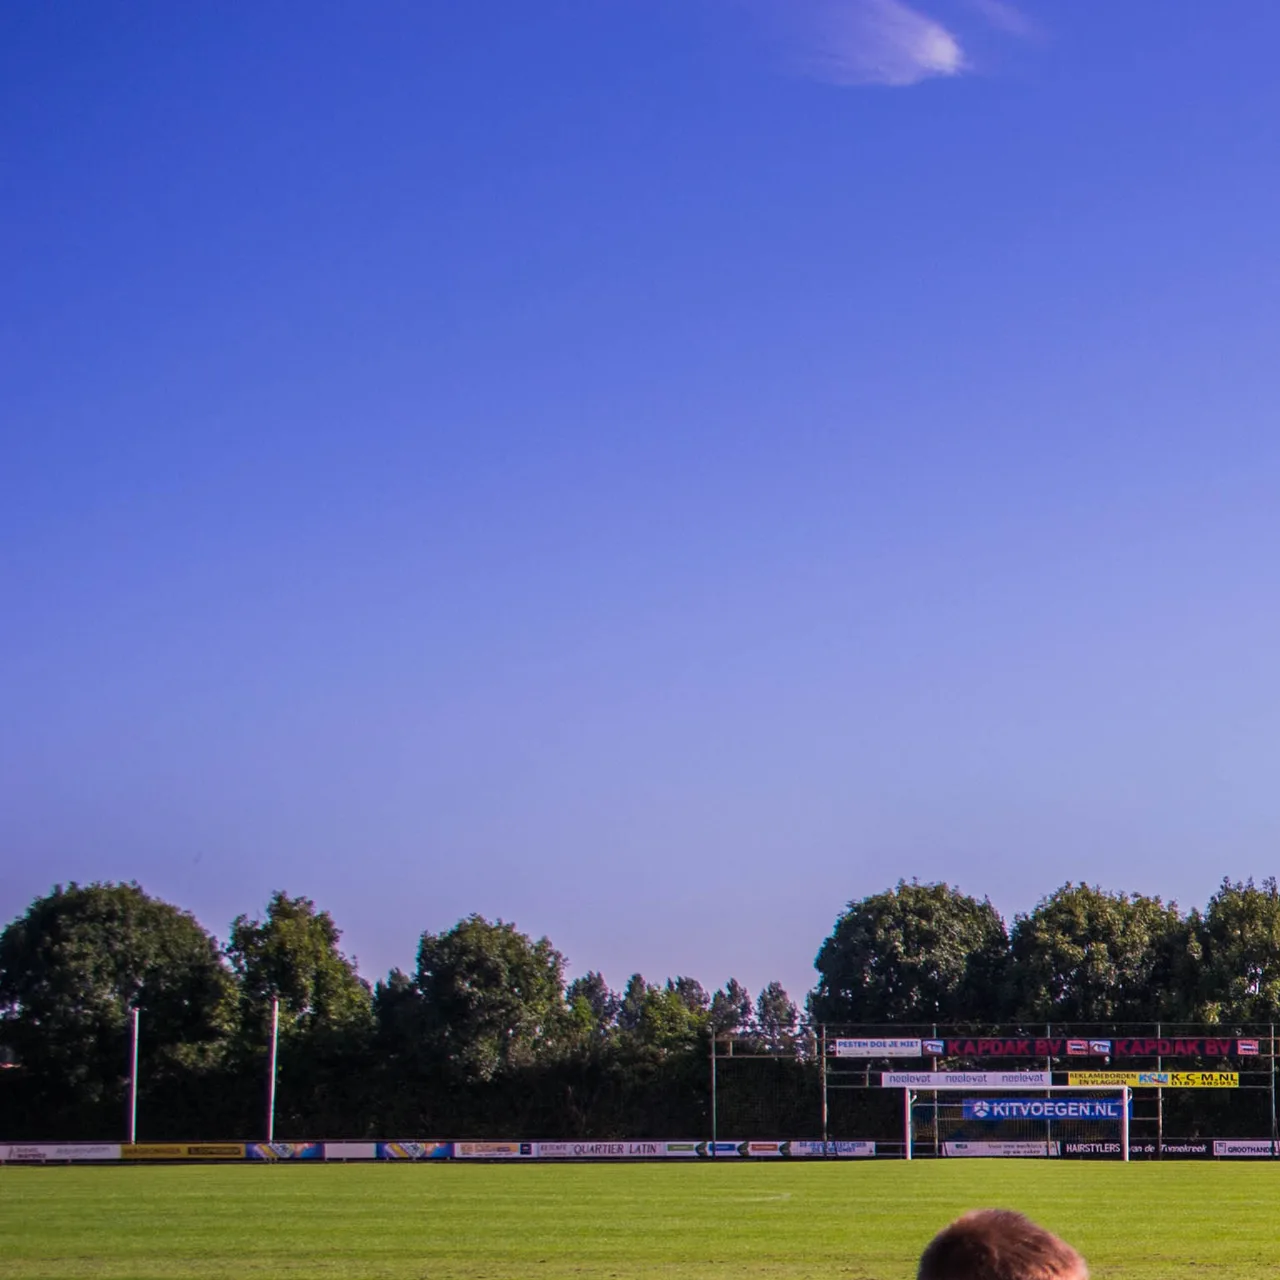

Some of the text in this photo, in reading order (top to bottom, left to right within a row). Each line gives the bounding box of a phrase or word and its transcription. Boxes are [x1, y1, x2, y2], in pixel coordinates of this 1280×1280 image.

[947, 1039, 1062, 1056] KAPDAK BV
[1114, 1039, 1232, 1056] KAPDAK BV
[1171, 1073, 1238, 1082] K-C-M.NL
[993, 1101, 1118, 1117] KITVOEGEN.NL
[1066, 1143, 1121, 1153] HAIRSTYLERS
[1144, 1144, 1155, 1153] de
